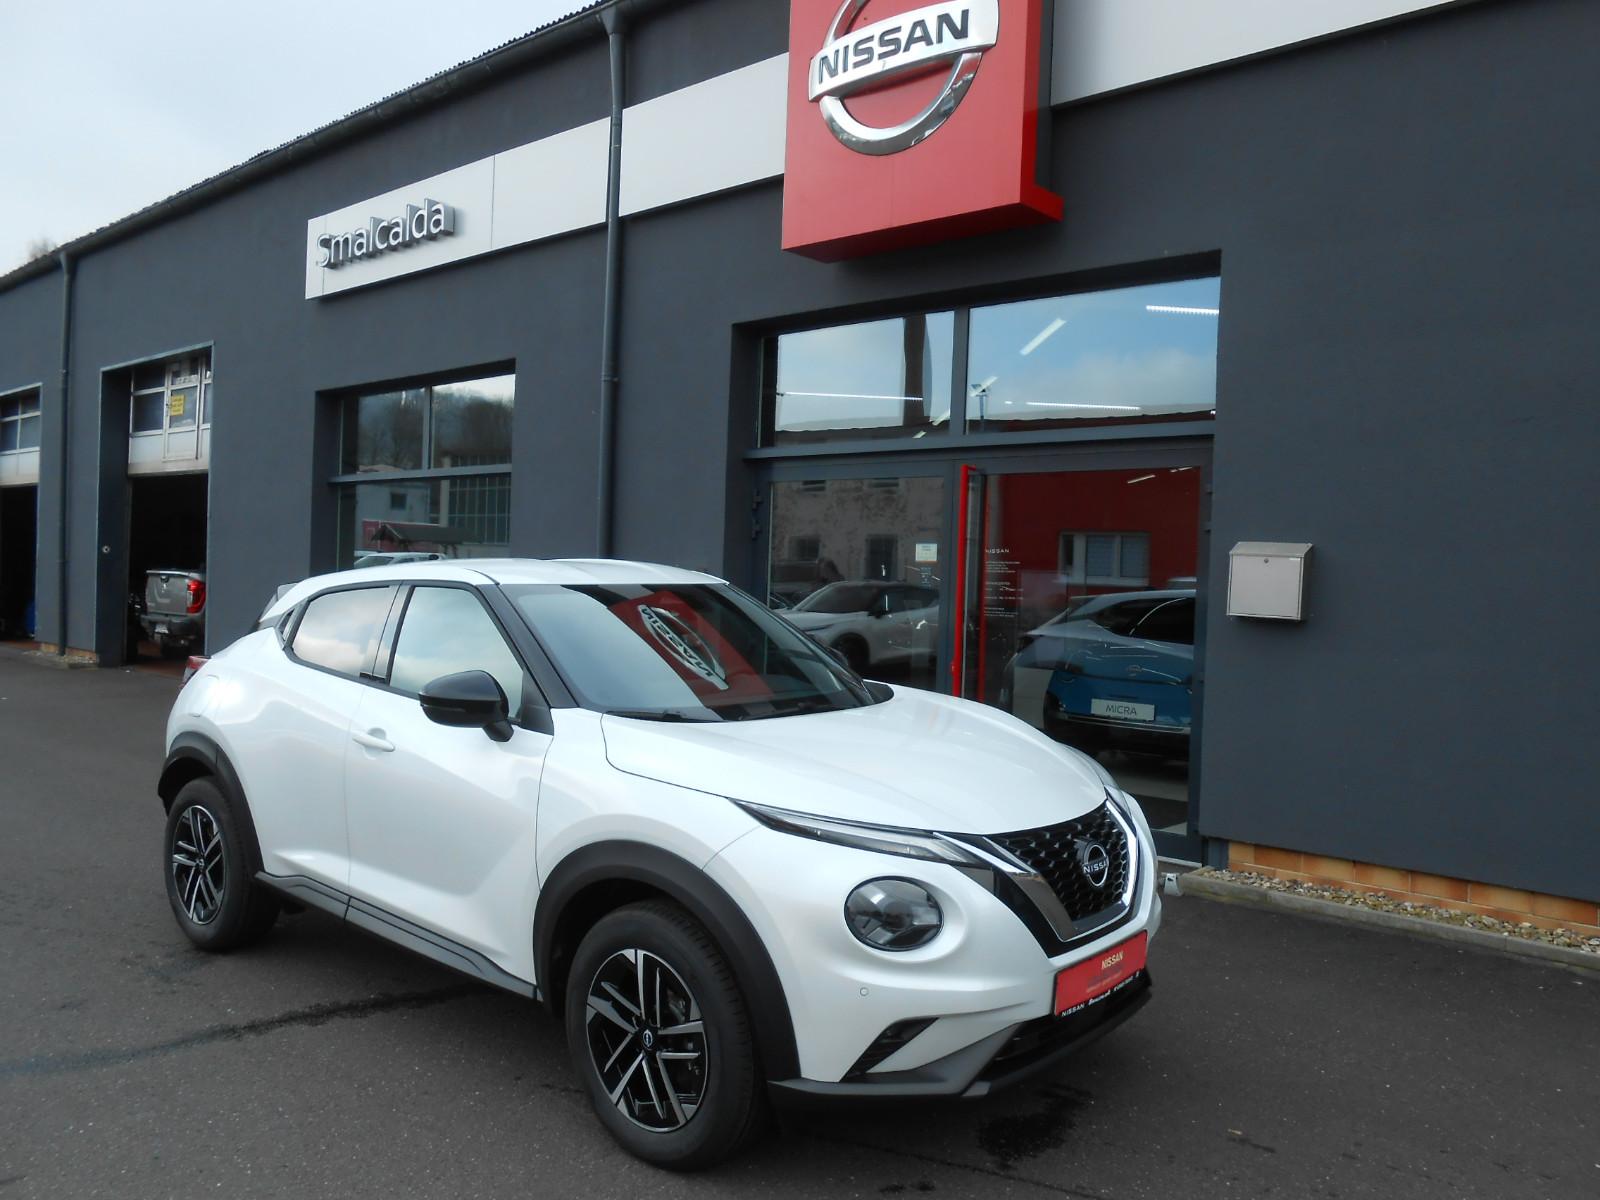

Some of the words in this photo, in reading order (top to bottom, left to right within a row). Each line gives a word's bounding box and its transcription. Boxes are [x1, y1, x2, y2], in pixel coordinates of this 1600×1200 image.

[818, 9, 970, 84] NISSAN
[317, 198, 451, 267] Smalcalda
[1105, 704, 1137, 716] MICRA
[1101, 951, 1124, 970] NISSAN
[1061, 1003, 1085, 1017] NISSAN
